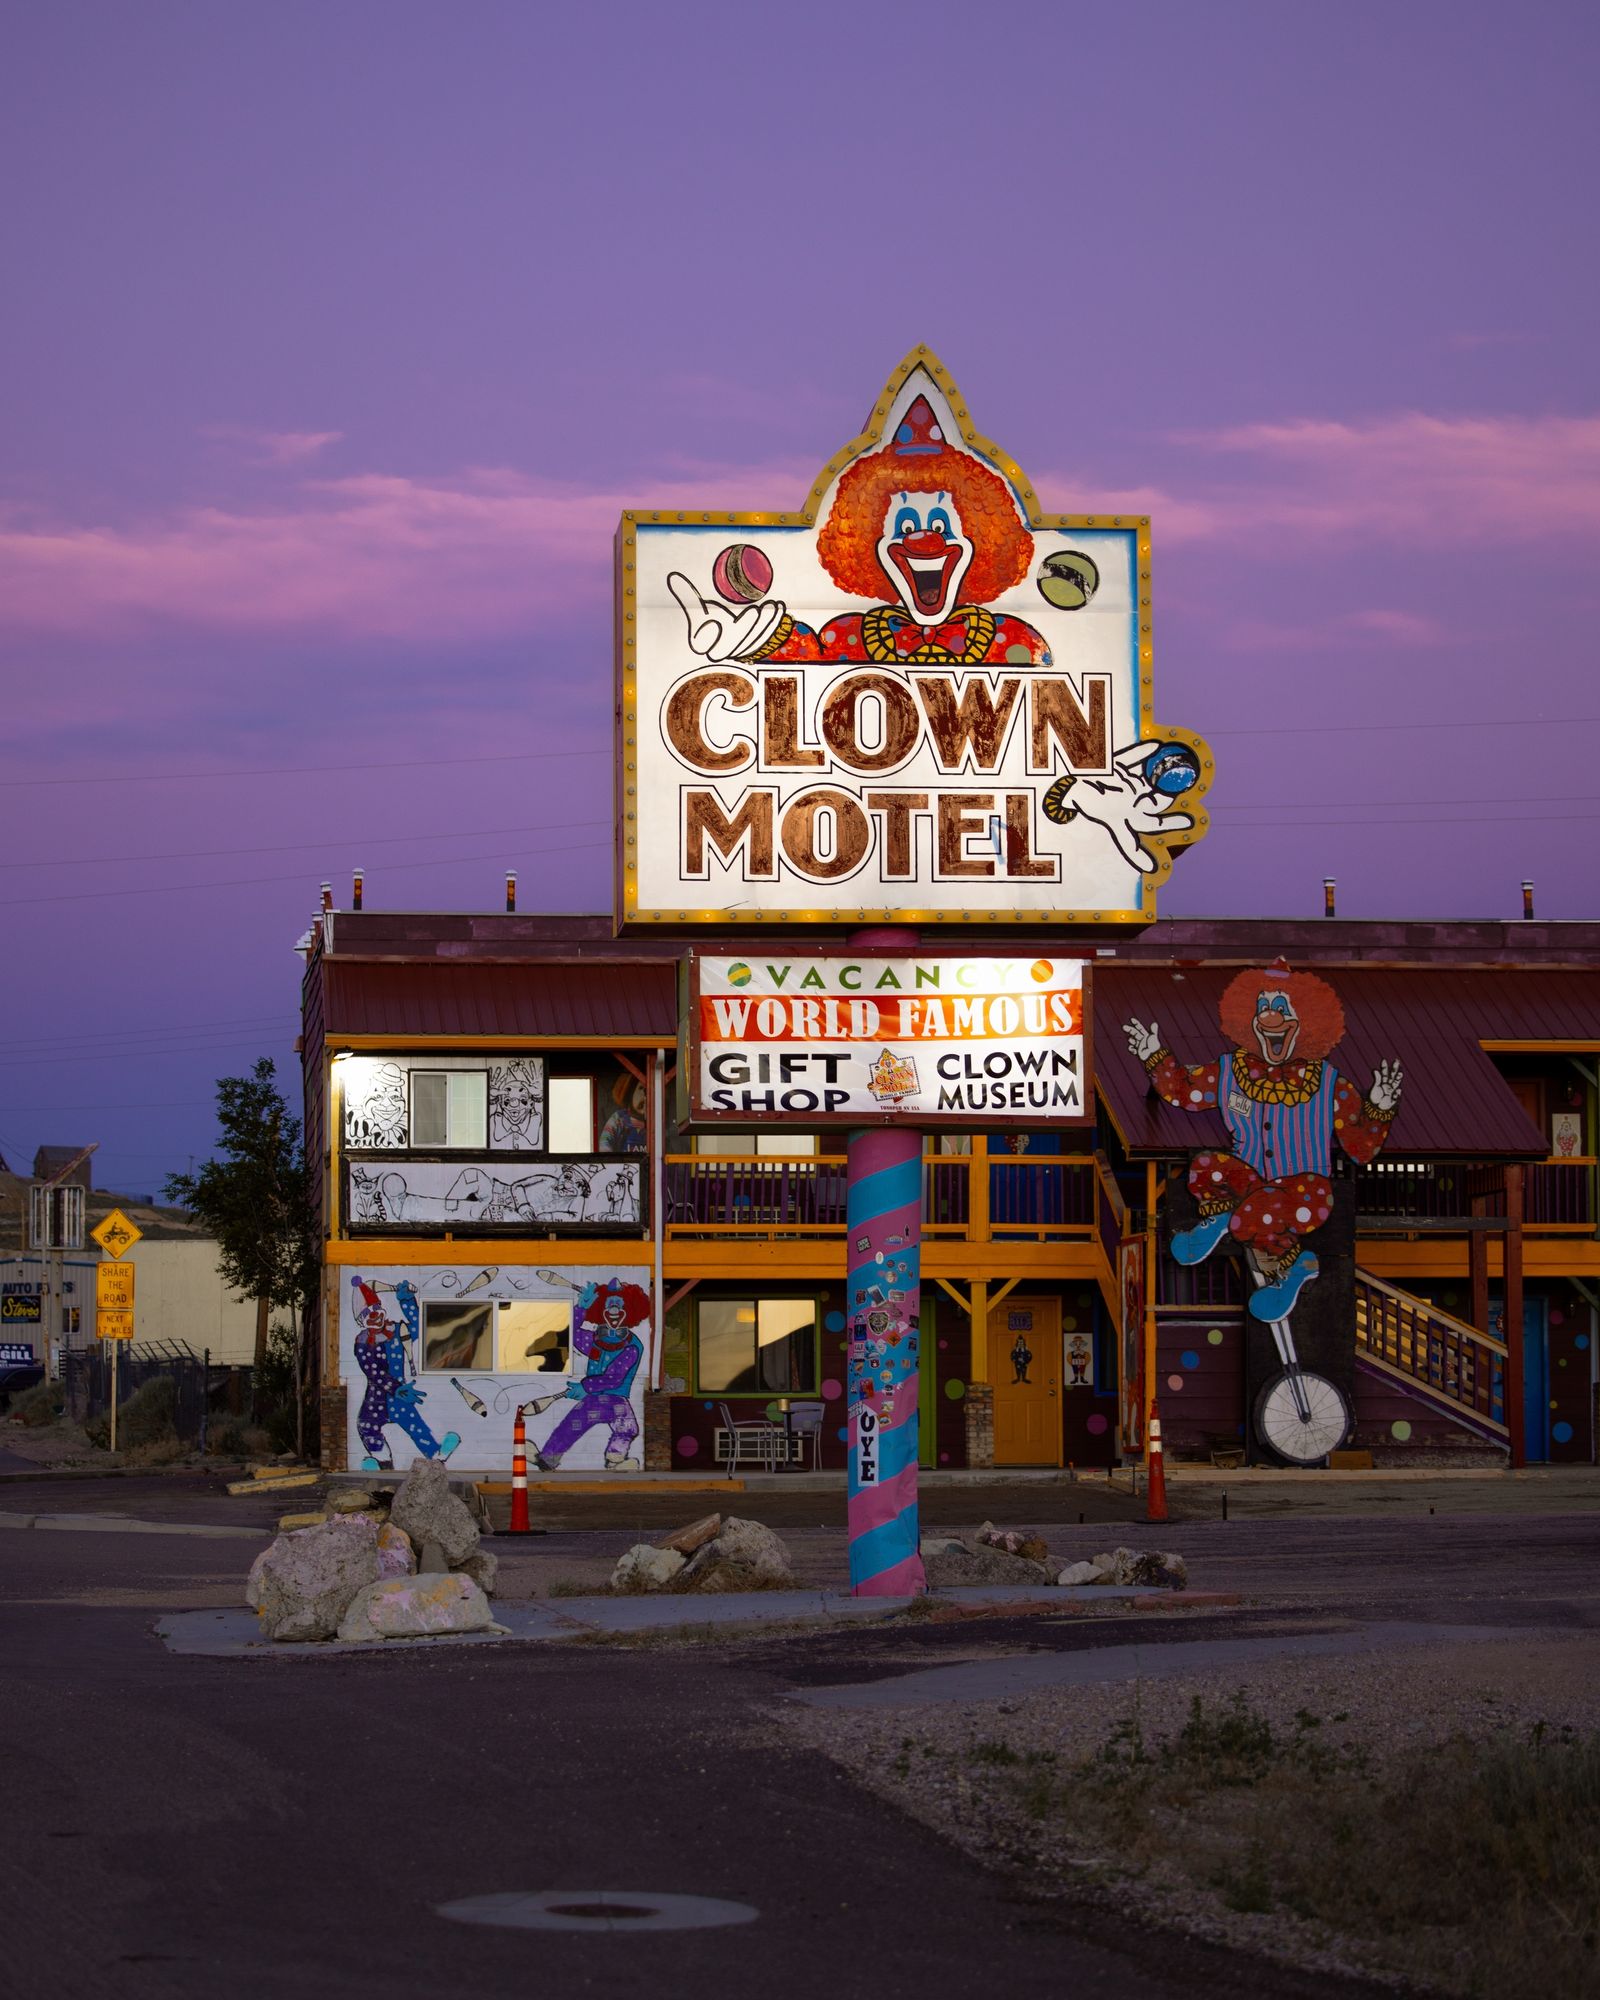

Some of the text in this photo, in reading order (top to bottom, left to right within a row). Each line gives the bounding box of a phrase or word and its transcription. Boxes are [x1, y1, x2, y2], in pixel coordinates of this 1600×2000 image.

[660, 666, 1113, 777] CLOWN
[680, 784, 1061, 883] MOTEL
[766, 962, 1015, 990] VACANCY
[711, 992, 1074, 1039] WORLD FAMOUS
[709, 1053, 852, 1085] GIFT
[936, 1049, 1079, 1081] CLOWN
[711, 1088, 851, 1112] SHOP
[936, 1081, 1081, 1112] MUSEUM
[102, 1267, 129, 1277] SHARE
[108, 1280, 123, 1289] THE
[2, 1282, 32, 1294] AUTO
[104, 1293, 127, 1303] ROAD
[106, 1315, 124, 1323] NEXT
[111, 1326, 132, 1334] MILES
